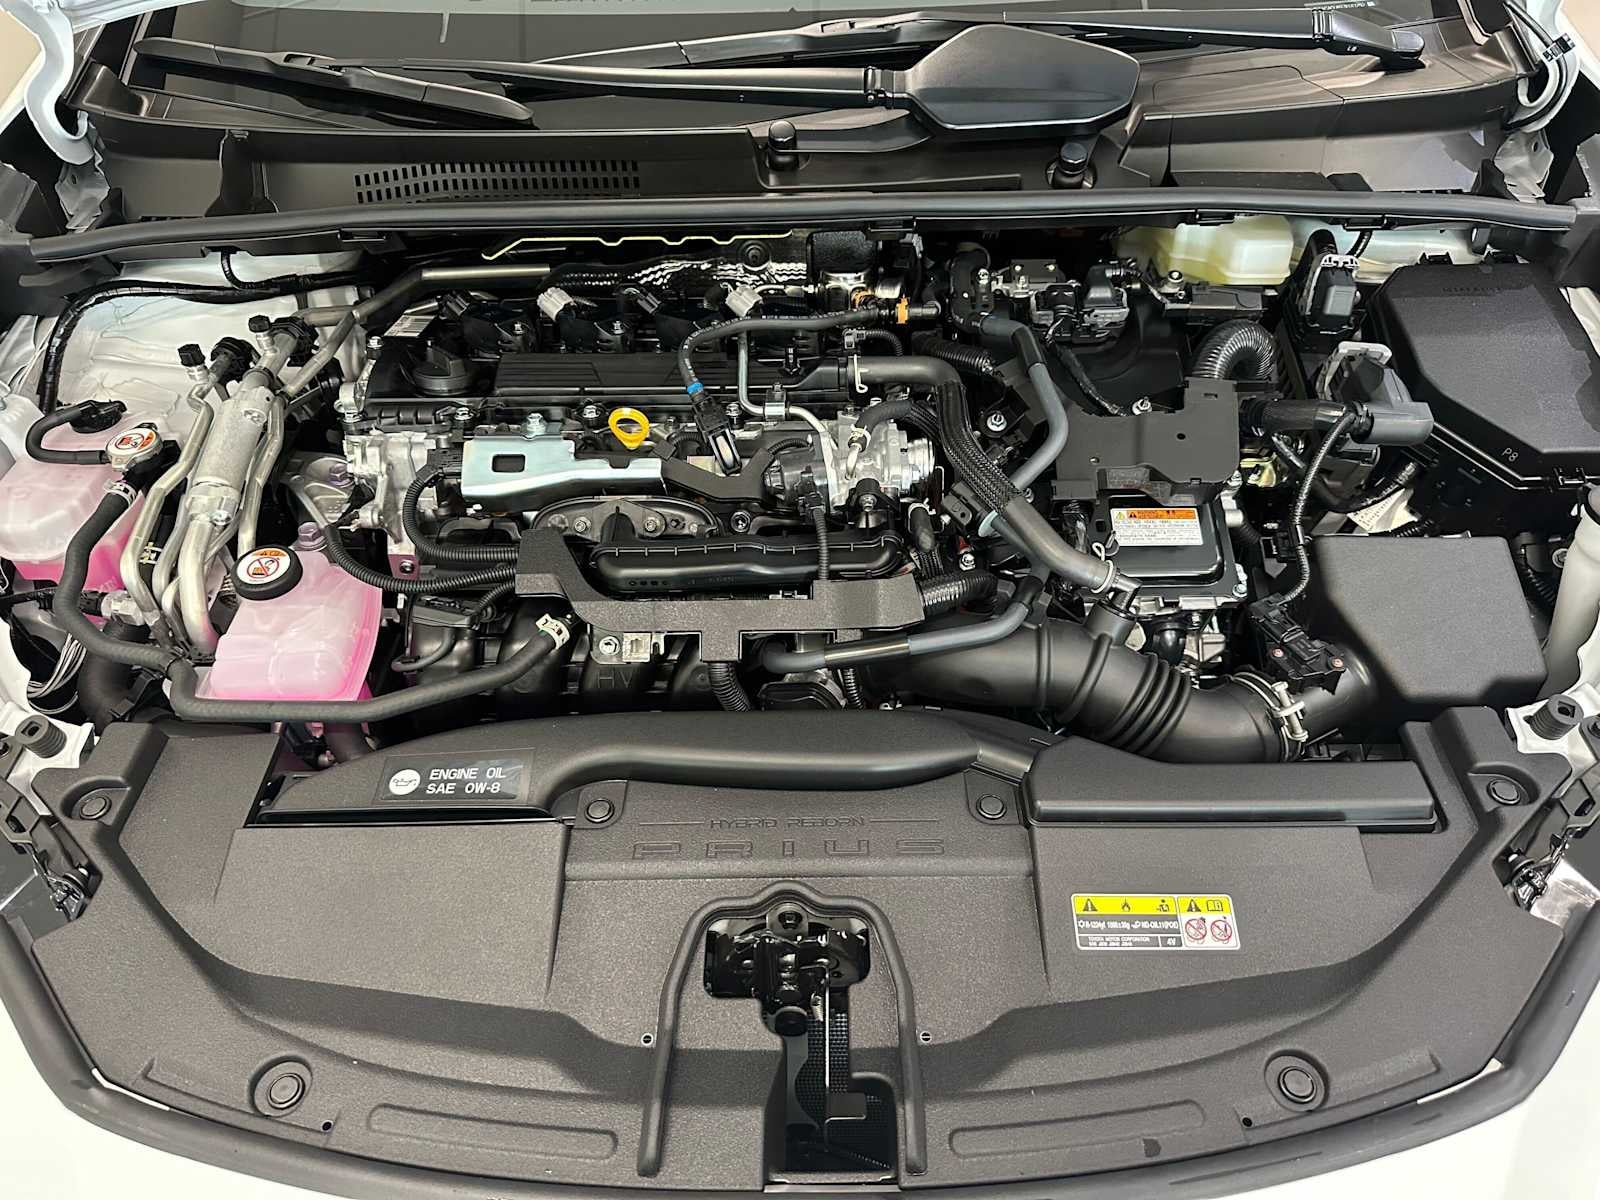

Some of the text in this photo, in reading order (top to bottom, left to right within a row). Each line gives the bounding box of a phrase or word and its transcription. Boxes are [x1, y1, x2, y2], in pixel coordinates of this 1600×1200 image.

[429, 767, 507, 780] ENGINE OIL
[426, 782, 456, 795] SAE
[710, 815, 865, 829] HYBRID REBORN
[632, 838, 945, 860] PRIUS
